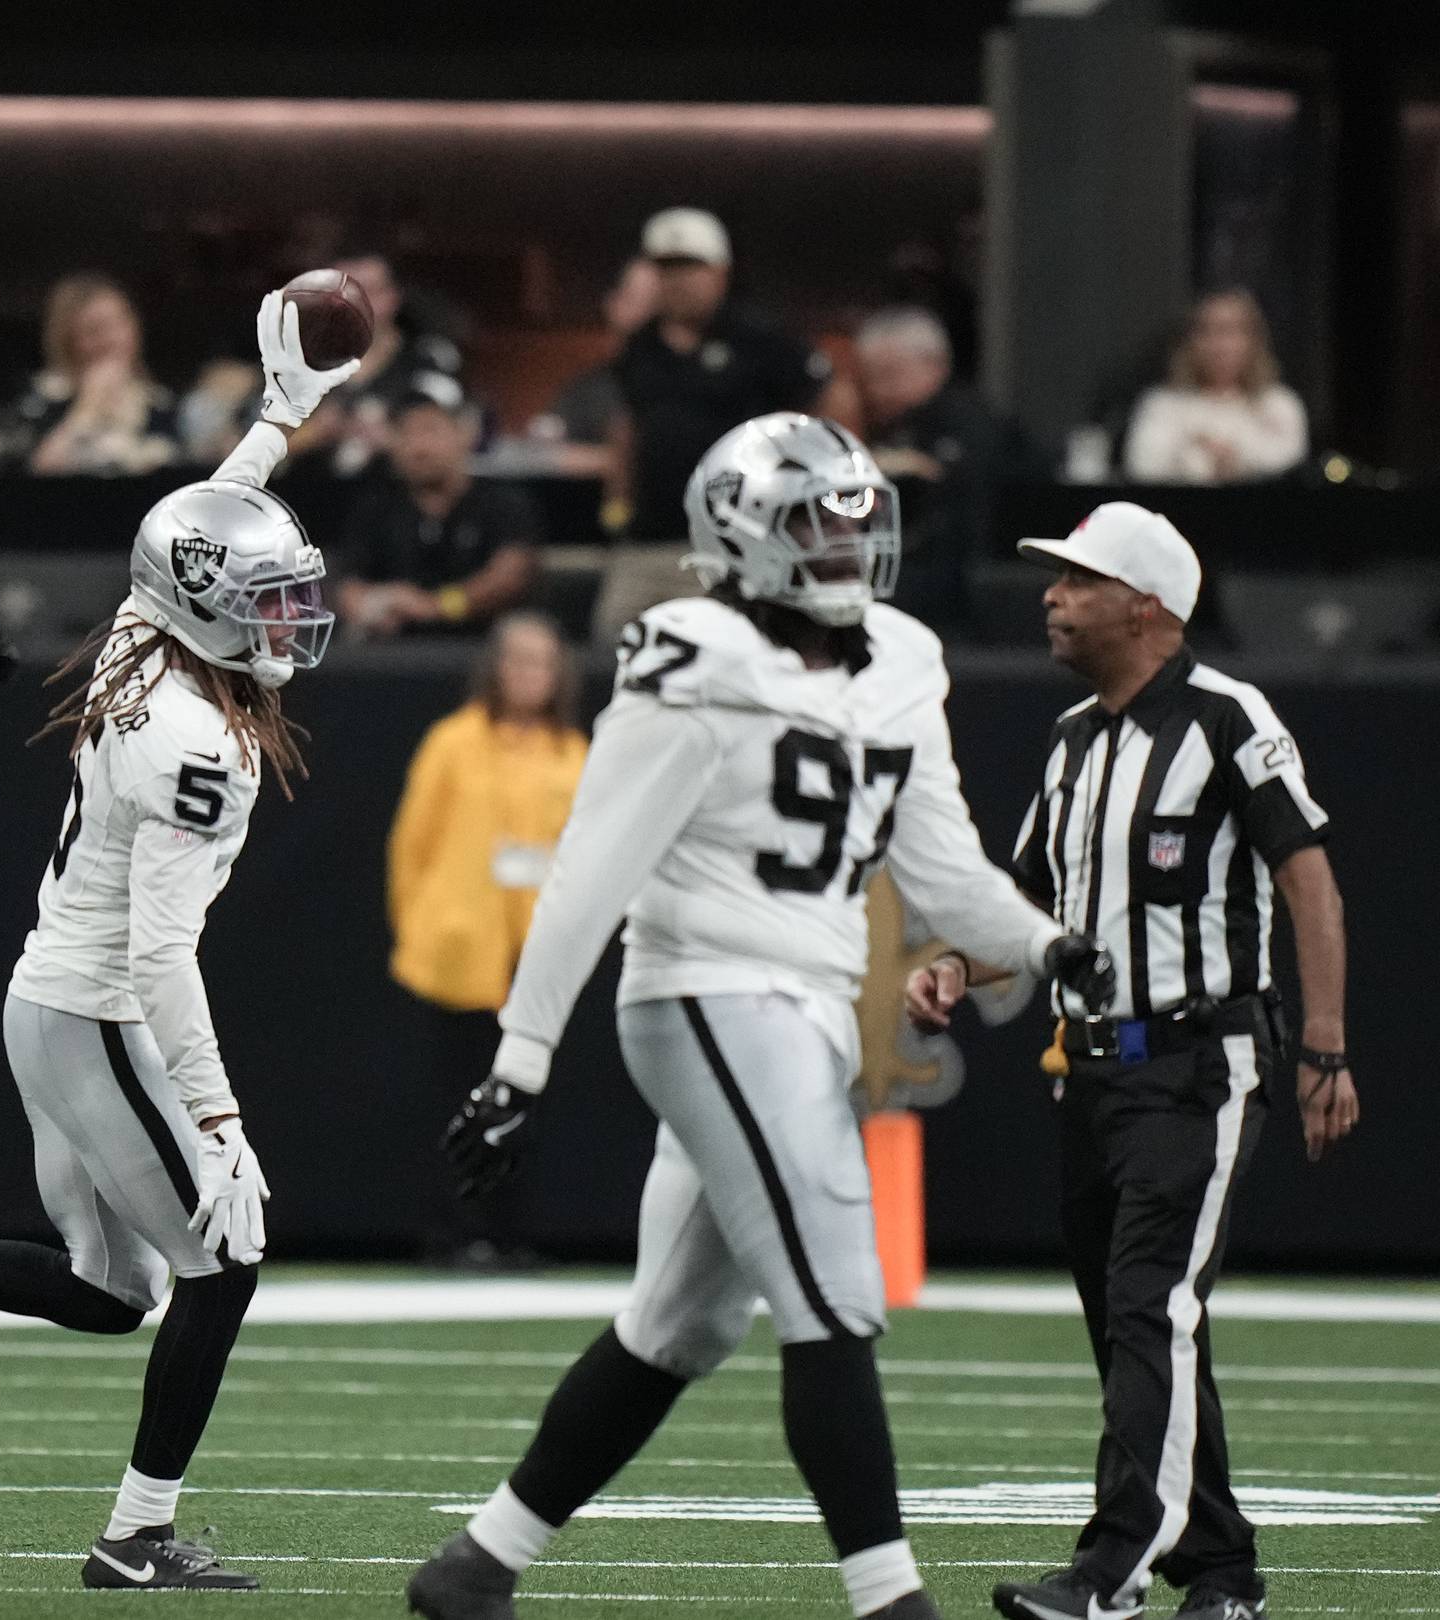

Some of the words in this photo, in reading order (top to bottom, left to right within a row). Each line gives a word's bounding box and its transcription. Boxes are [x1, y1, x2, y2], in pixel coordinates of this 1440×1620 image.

[1255, 736, 1296, 770] 29
[174, 763, 228, 828] 5
[755, 728, 914, 896] 97
